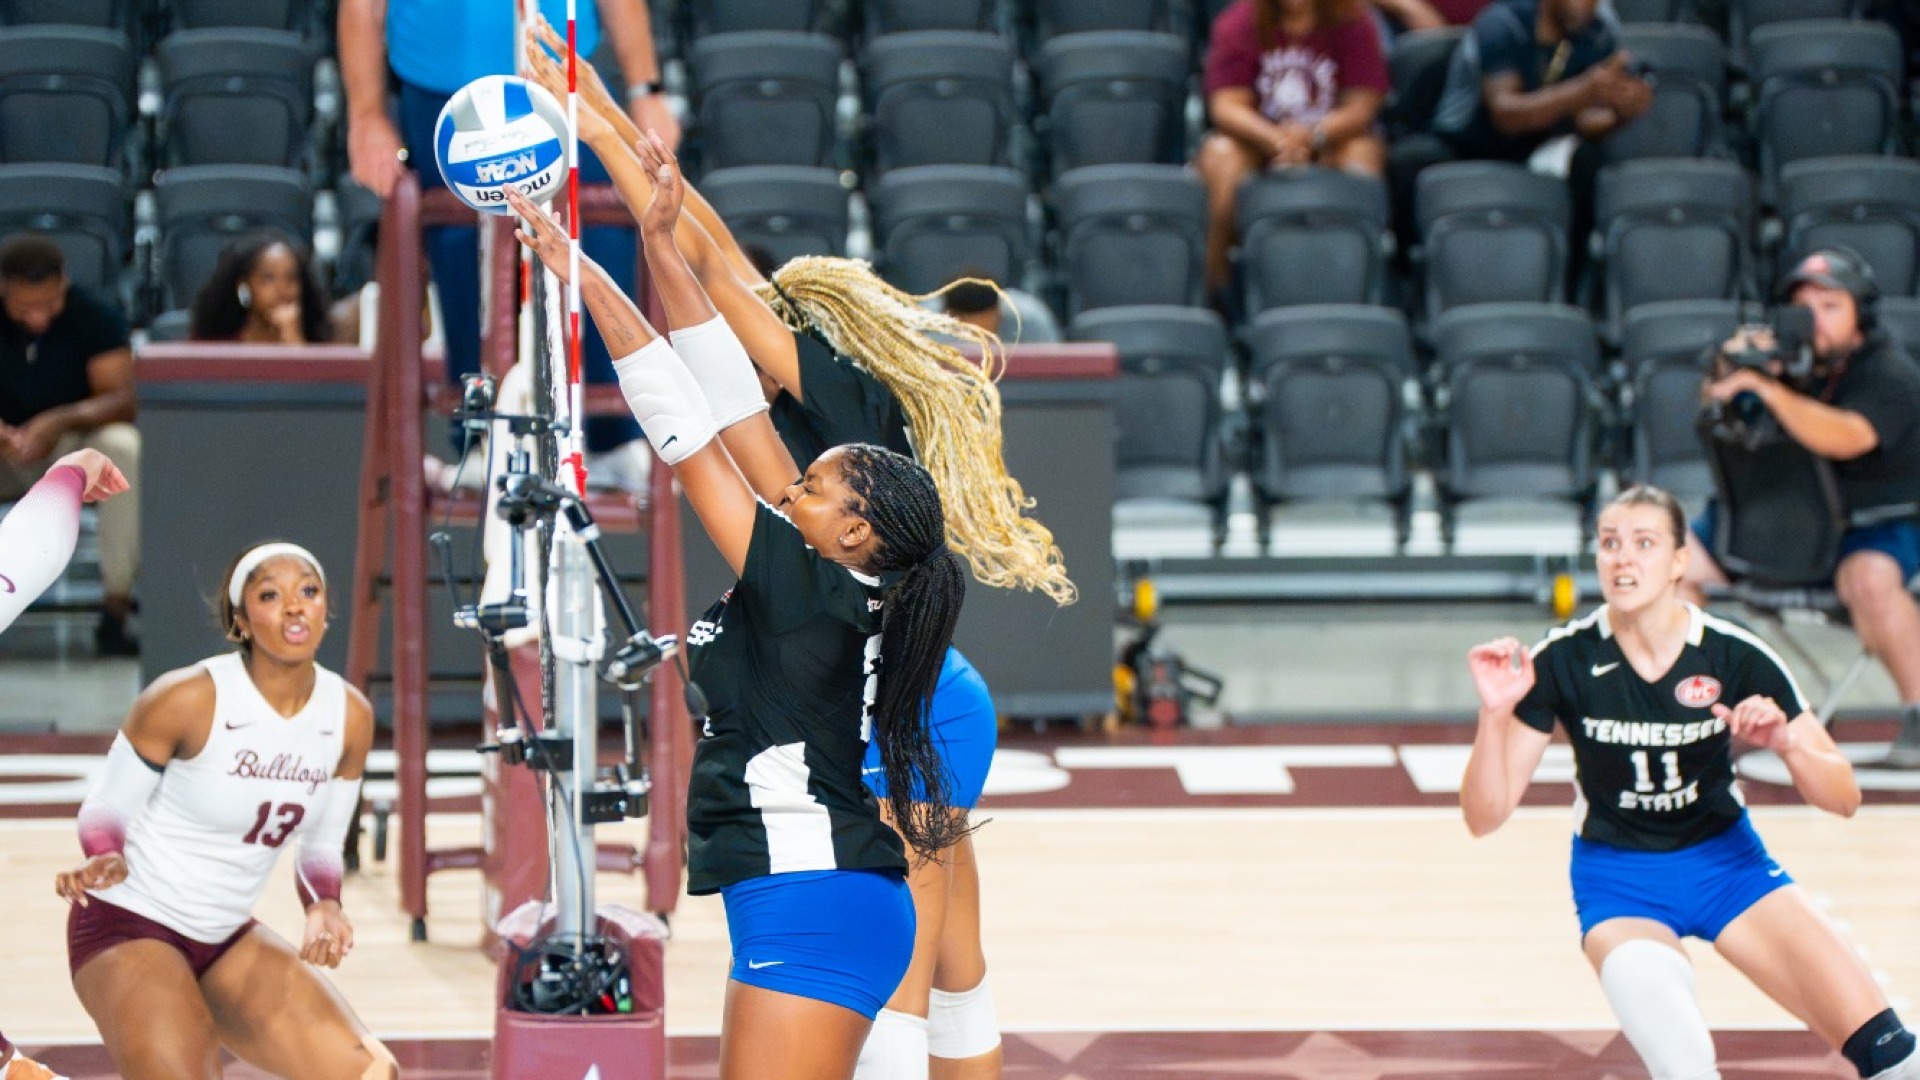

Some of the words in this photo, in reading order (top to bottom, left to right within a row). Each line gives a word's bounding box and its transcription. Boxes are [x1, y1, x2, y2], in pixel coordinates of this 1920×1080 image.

[475, 150, 538, 184] NCAA
[476, 172, 551, 202] moen
[227, 748, 328, 796] Bulldogs
[1630, 751, 1682, 792] 11
[1618, 780, 1699, 812] STATE
[242, 801, 306, 848] 13
